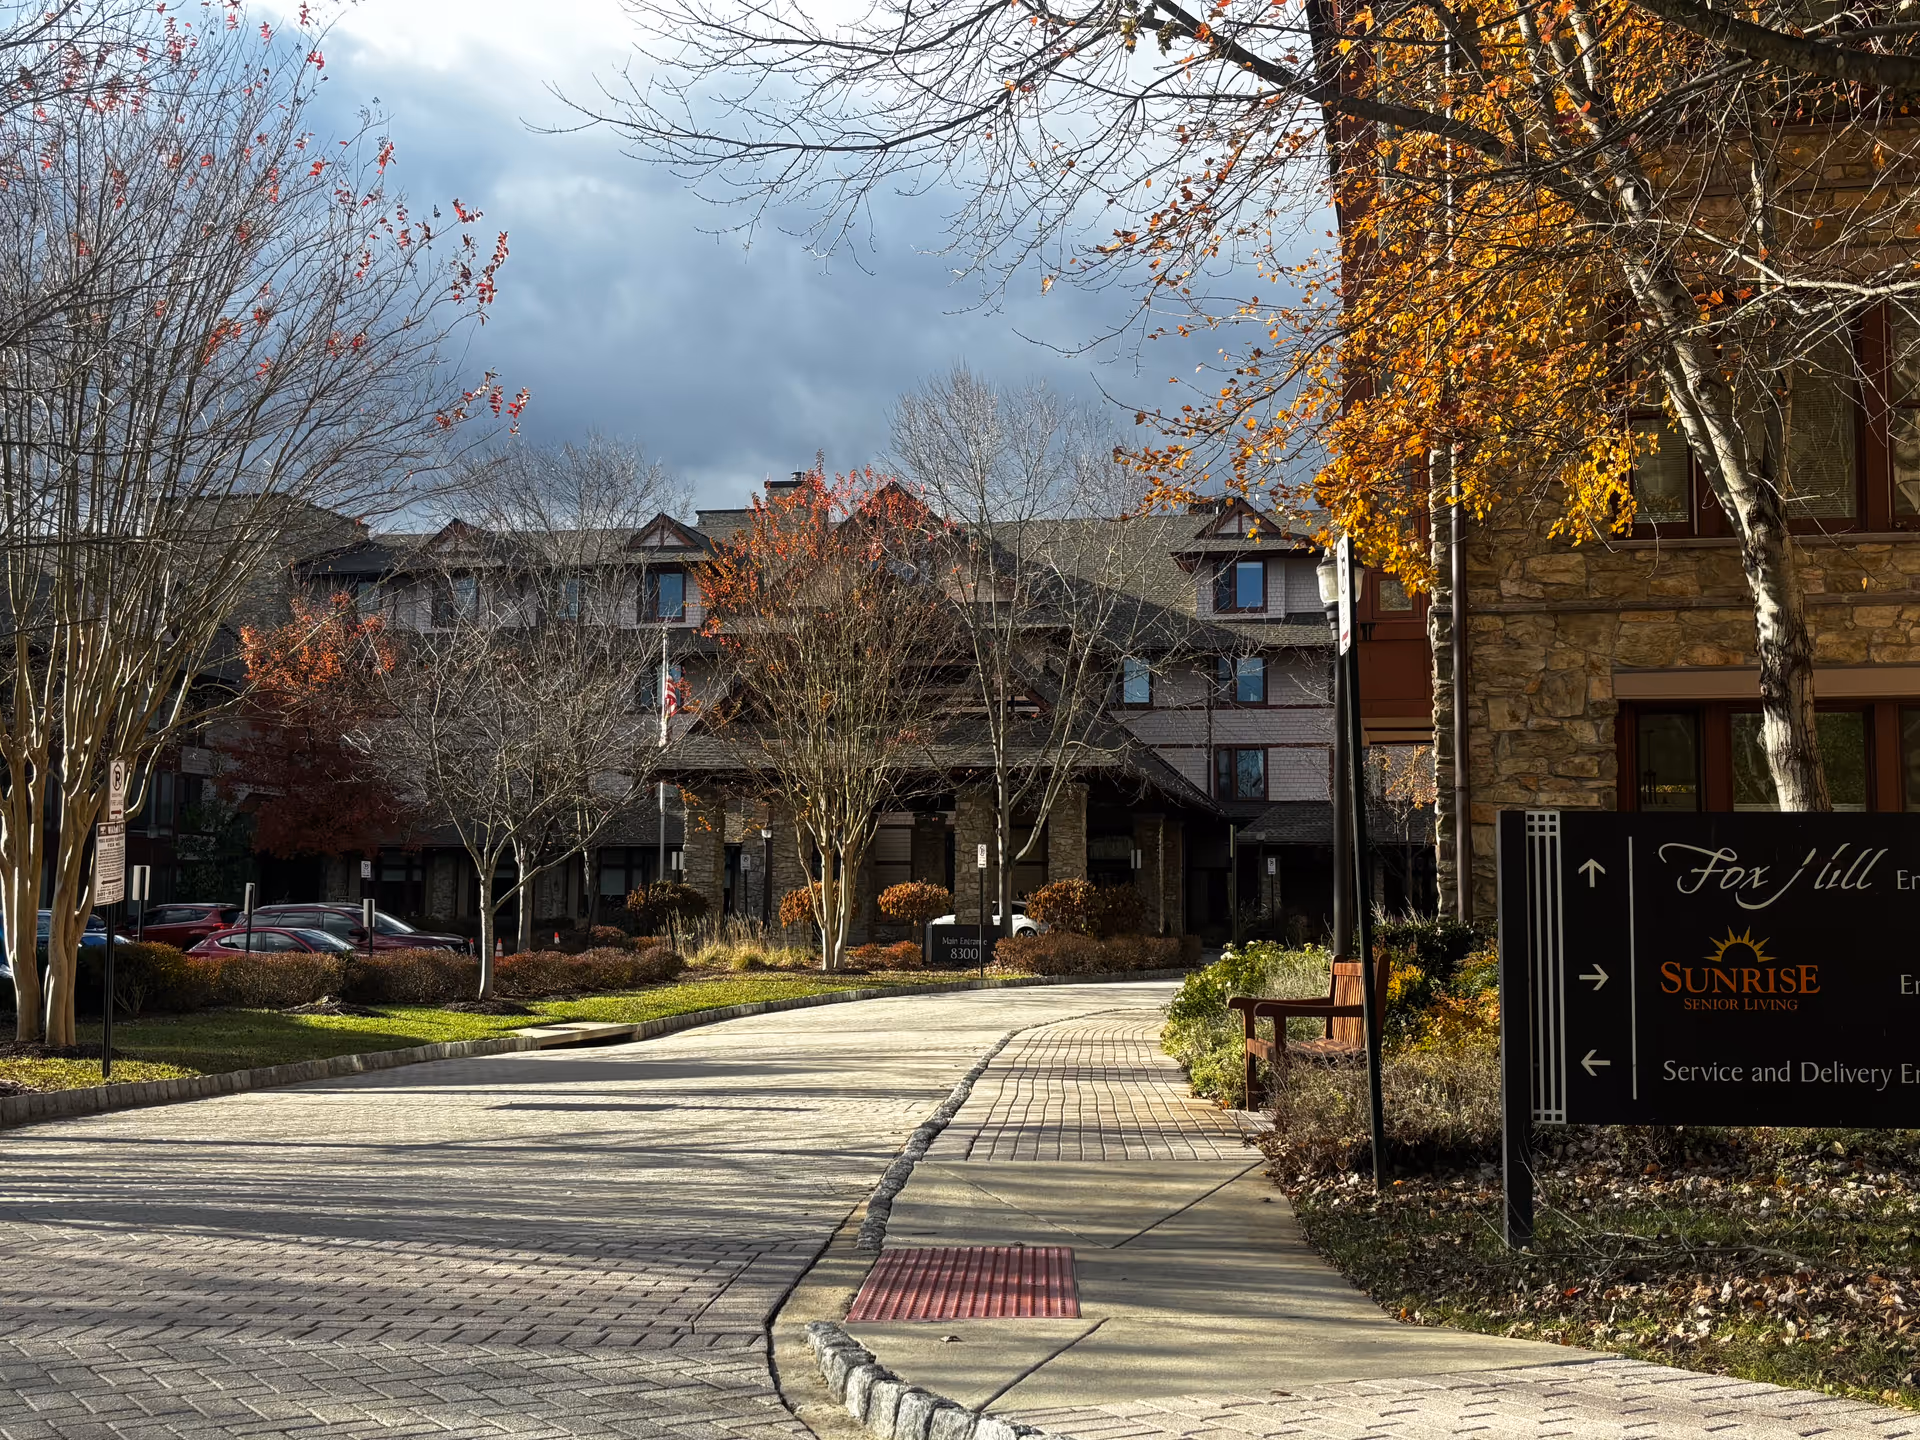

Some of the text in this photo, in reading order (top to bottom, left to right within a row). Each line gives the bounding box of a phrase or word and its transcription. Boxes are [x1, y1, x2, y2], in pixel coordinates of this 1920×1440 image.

[1657, 842, 1771, 895] Fox
[1734, 842, 1890, 910] Hill
[941, 936, 988, 946] Main Entrane
[950, 947, 979, 960] 8300
[1660, 960, 1821, 994] SUNRISE
[1683, 997, 1799, 1011] SENIOR LIVING
[1662, 1059, 1744, 1082] Service
[1751, 1060, 1791, 1082] and
[1801, 1061, 1893, 1092] Delivery
